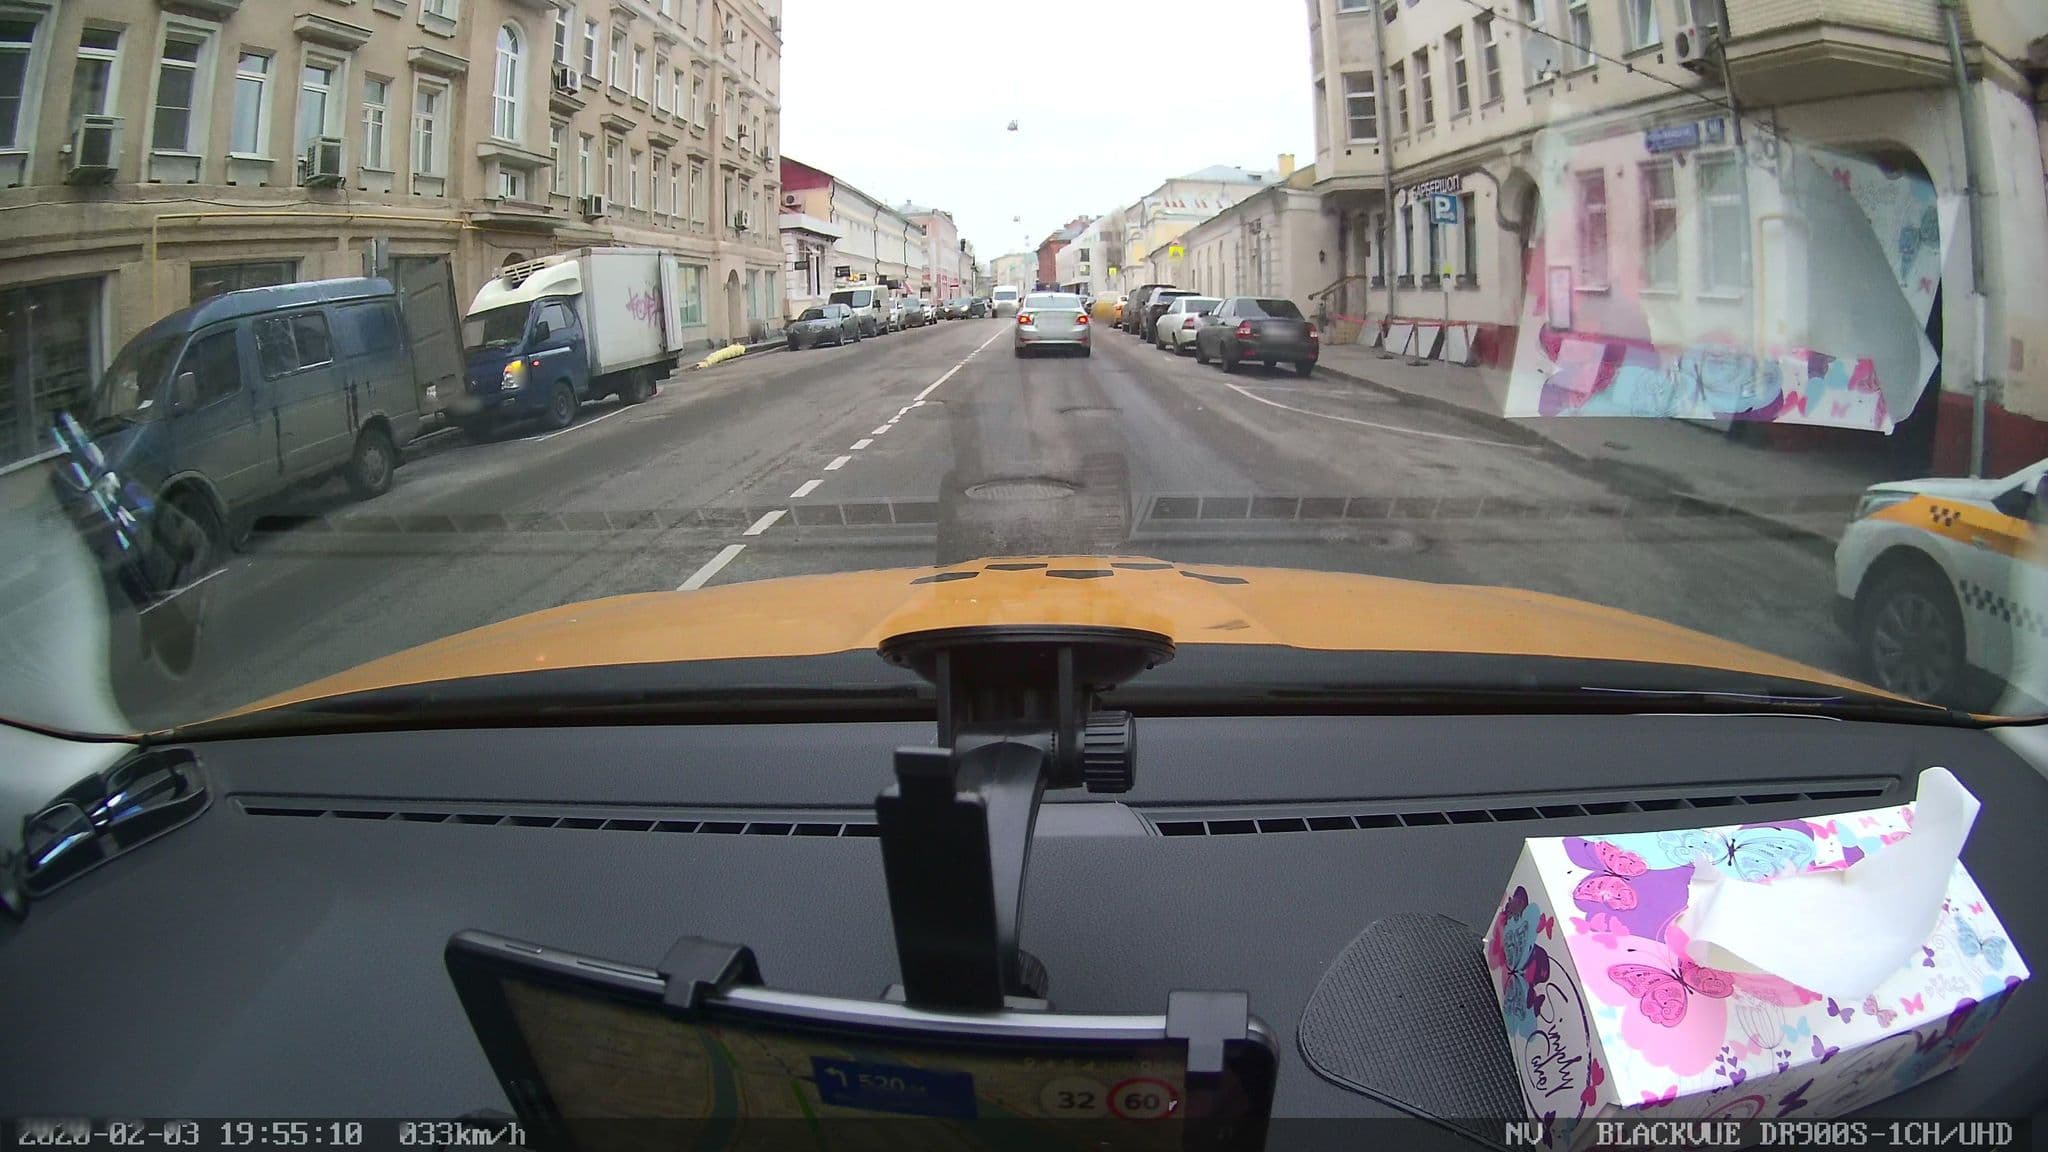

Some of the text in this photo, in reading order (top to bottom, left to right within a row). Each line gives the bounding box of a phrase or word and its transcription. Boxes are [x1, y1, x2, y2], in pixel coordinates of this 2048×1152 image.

[1540, 982, 1582, 1098] Simply
[1057, 1090, 1096, 1110] 32
[1124, 1093, 1161, 1111] 60
